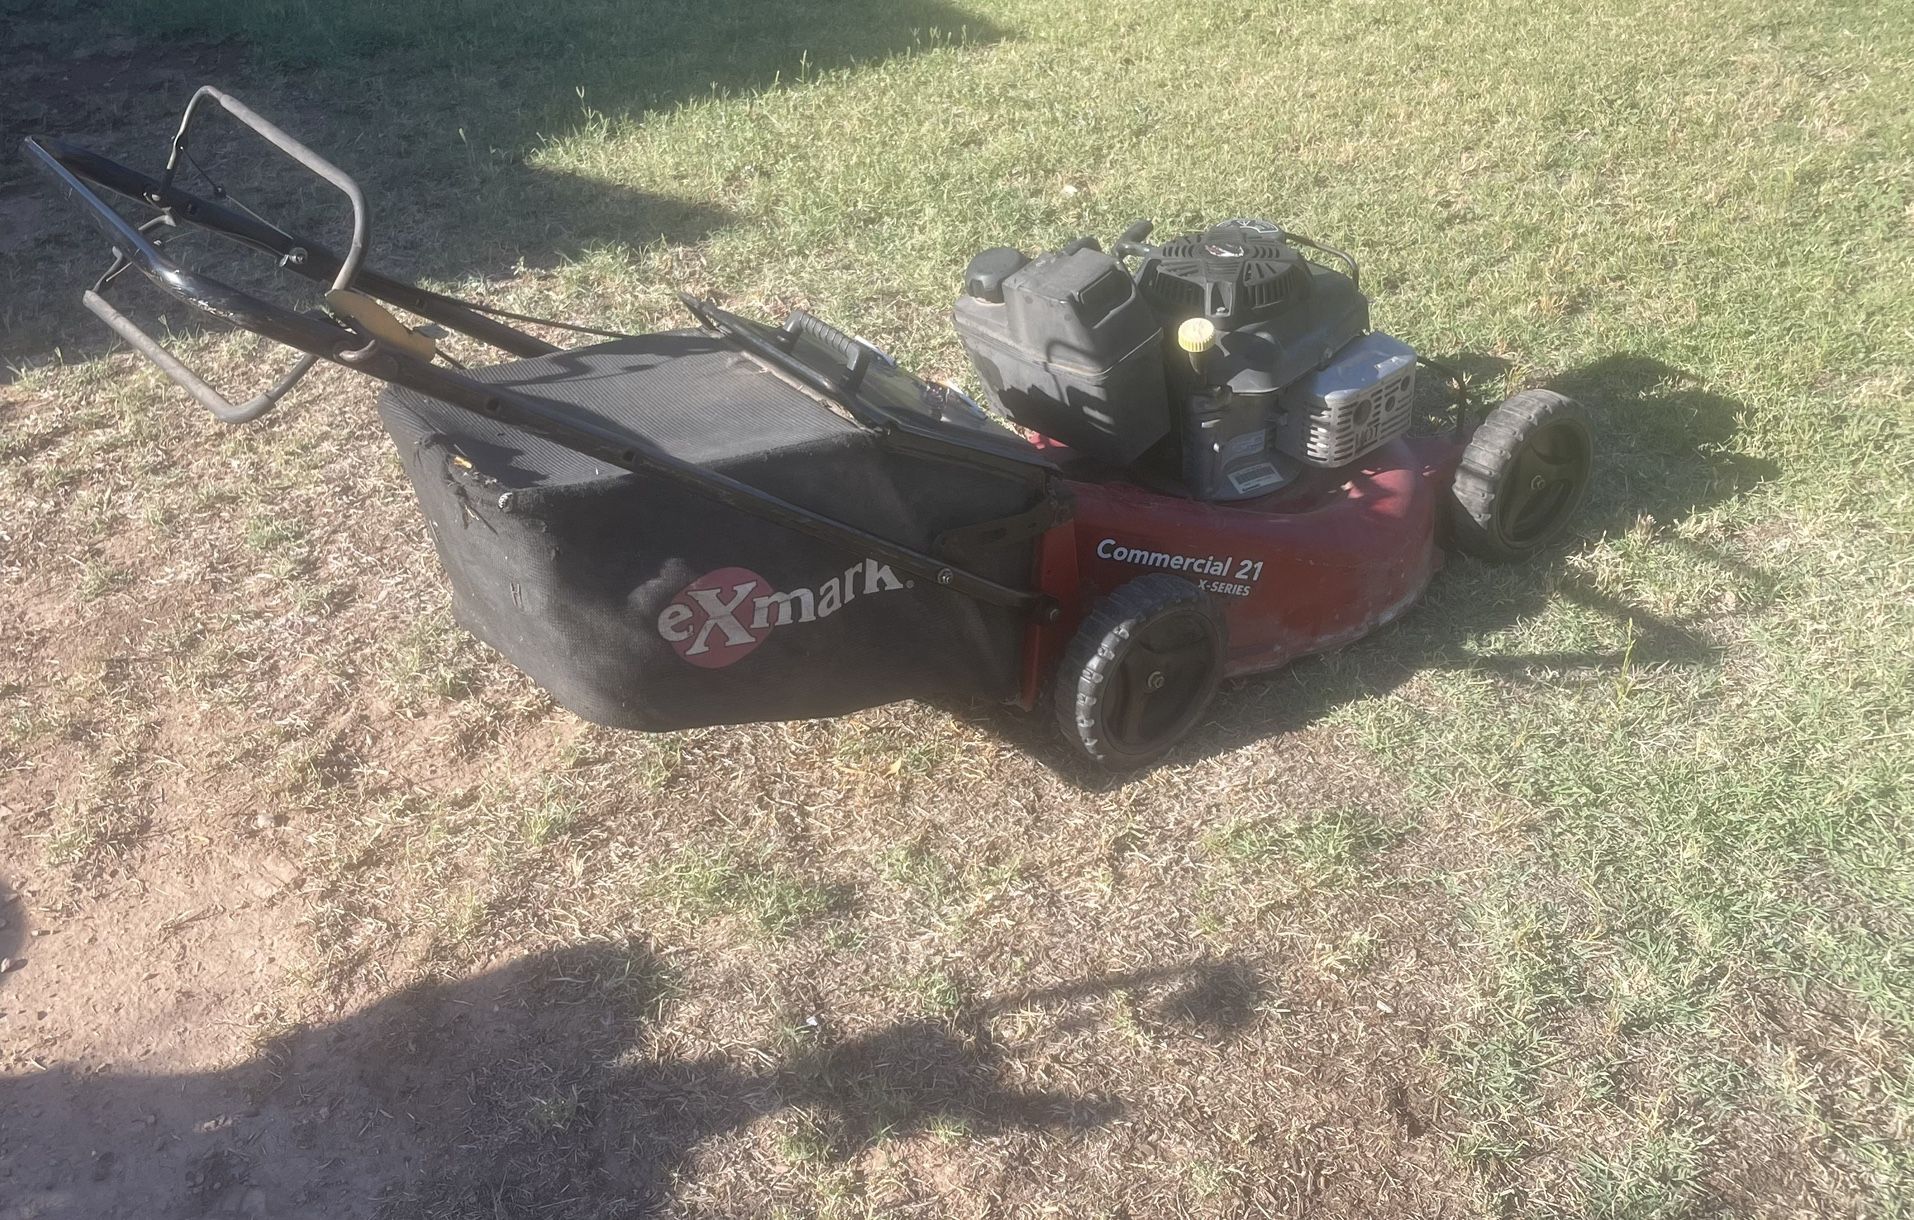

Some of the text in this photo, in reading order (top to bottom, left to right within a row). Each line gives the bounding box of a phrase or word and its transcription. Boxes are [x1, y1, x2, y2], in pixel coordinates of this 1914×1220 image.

[1096, 538, 1264, 581] Commercial 21
[1198, 578, 1252, 597] X-SERIES
